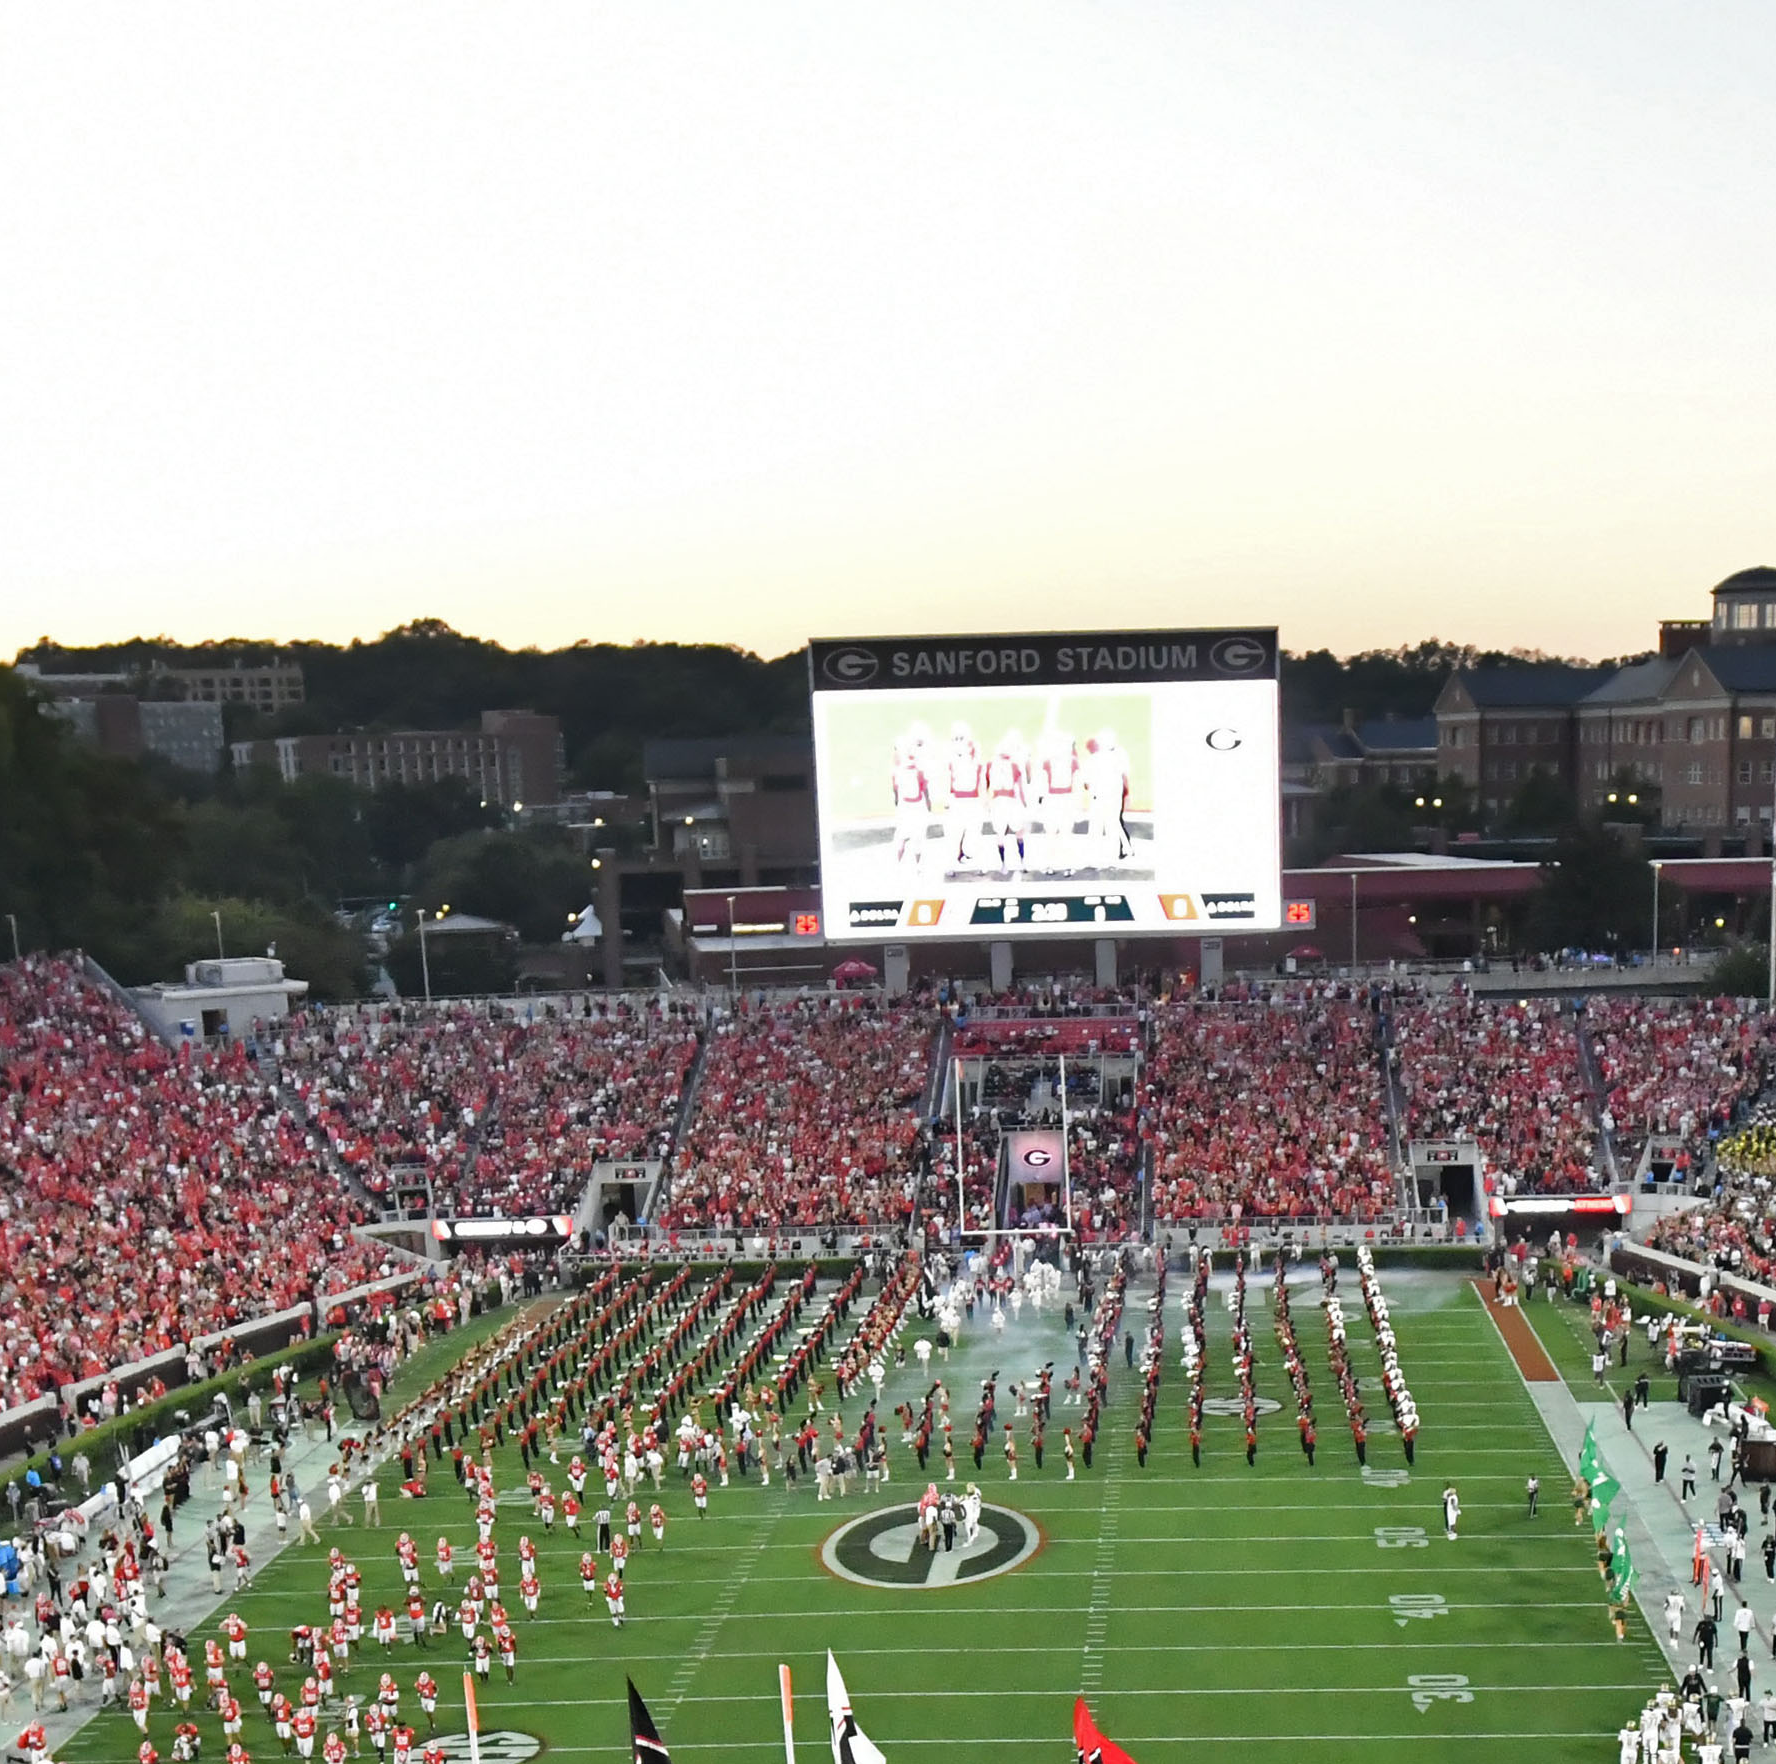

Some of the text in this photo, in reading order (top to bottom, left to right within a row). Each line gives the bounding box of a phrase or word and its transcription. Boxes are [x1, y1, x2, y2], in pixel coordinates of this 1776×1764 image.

[891, 649, 1041, 677] SANFORD
[1056, 644, 1198, 672] STADIUM
[1286, 903, 1310, 922] 25
[795, 914, 819, 934] 25
